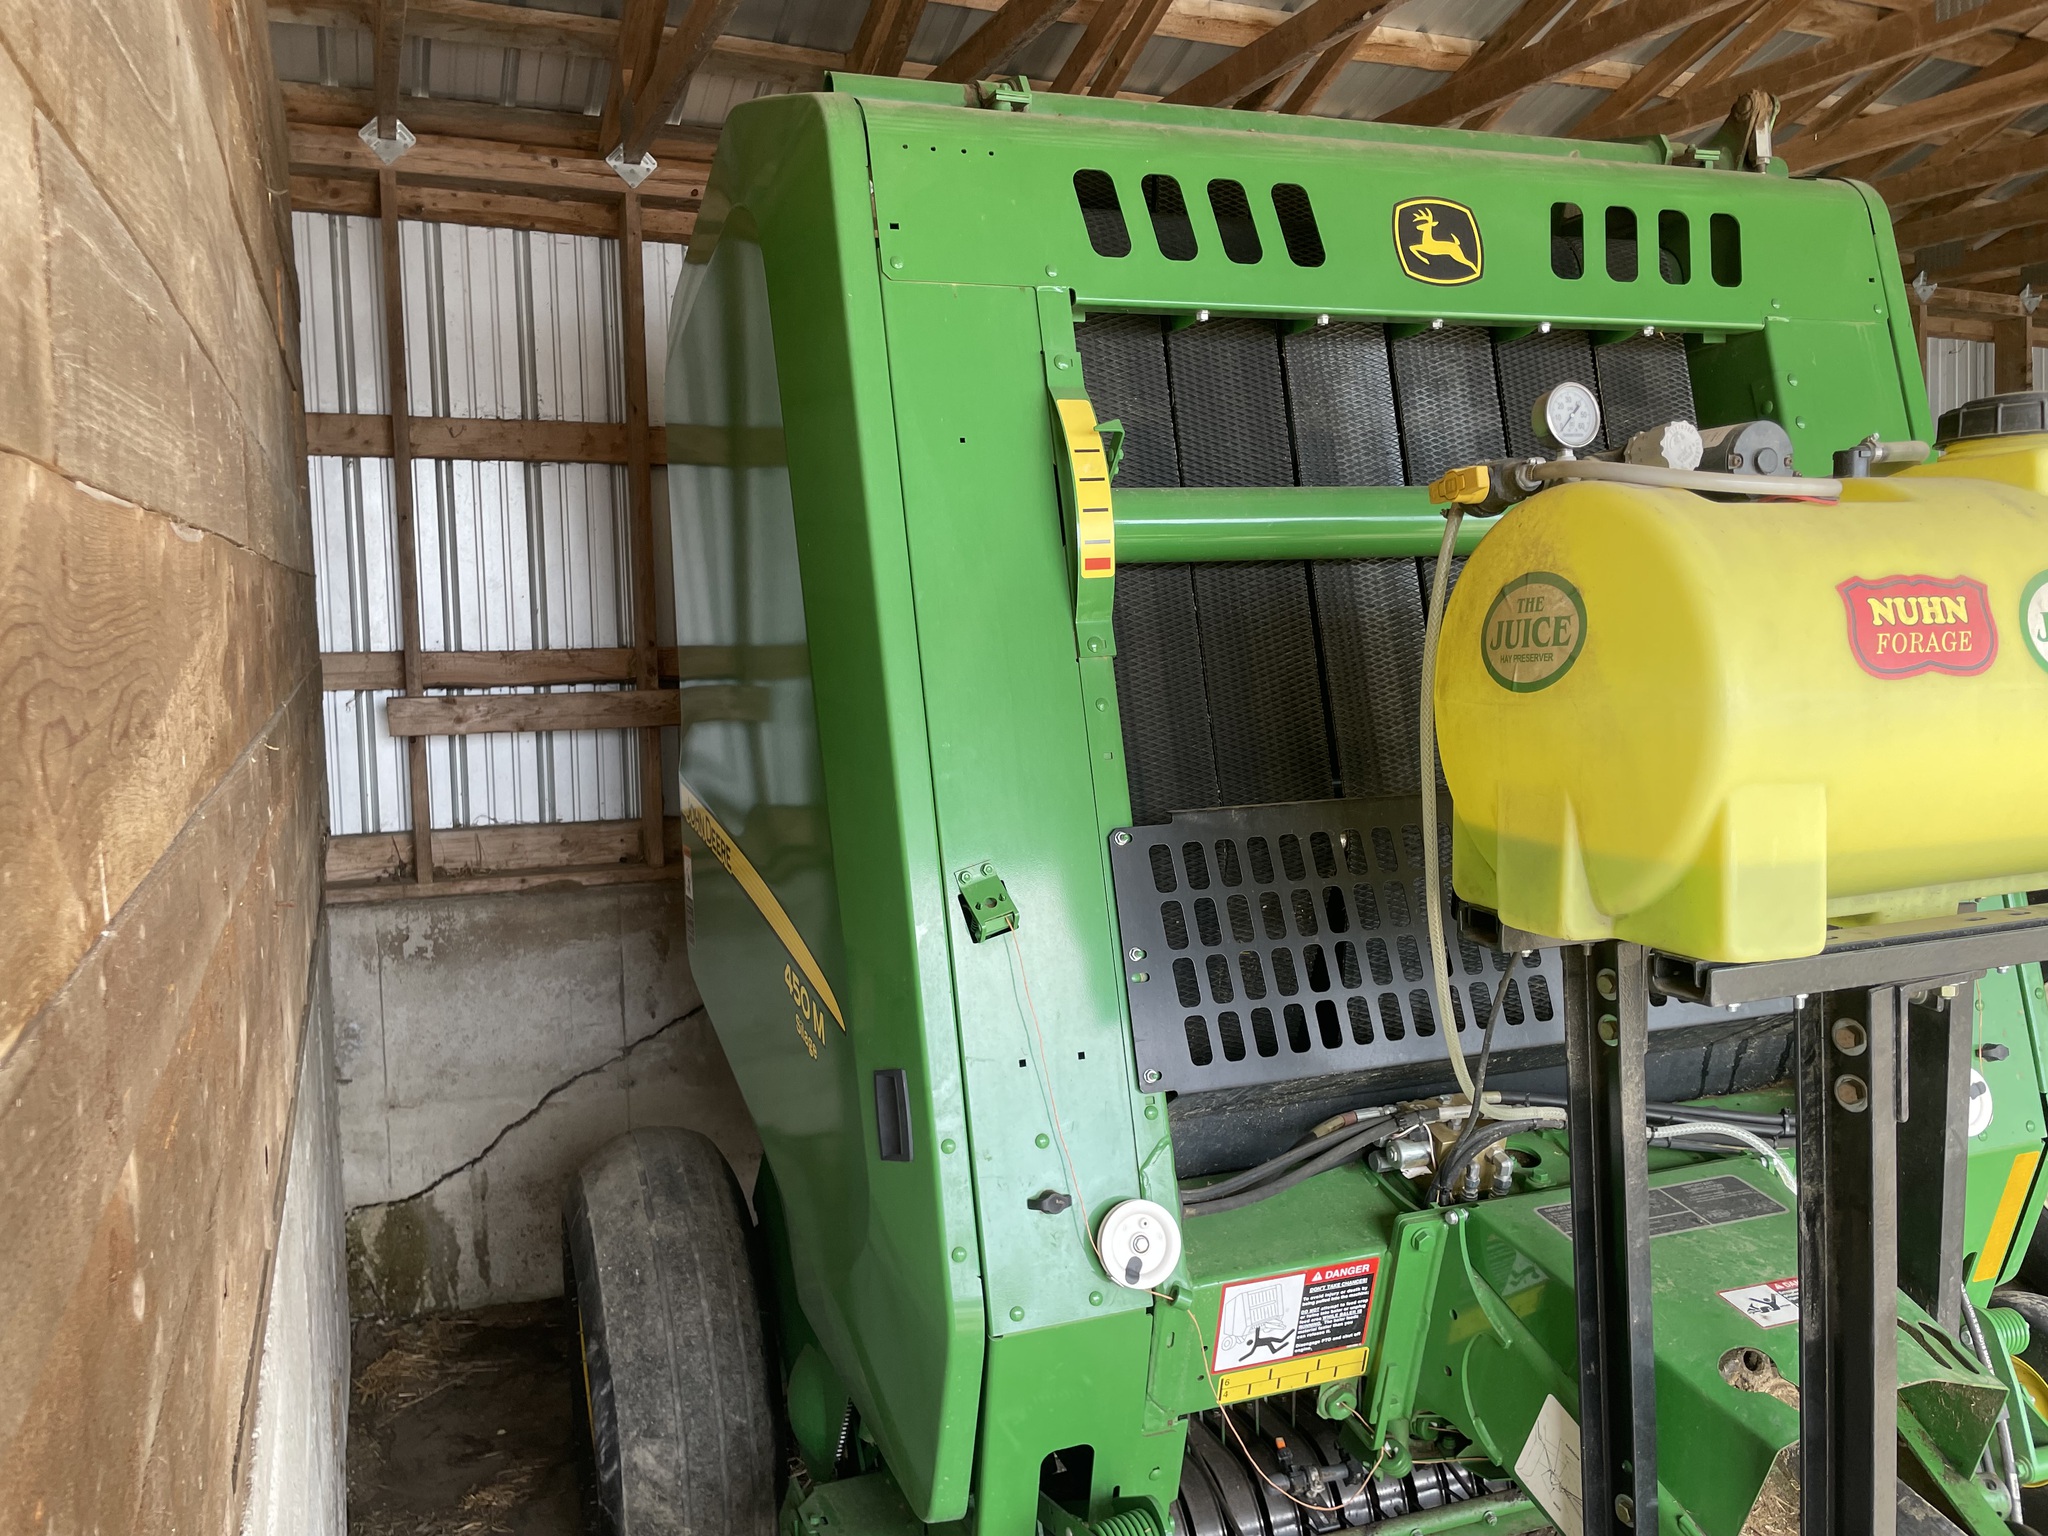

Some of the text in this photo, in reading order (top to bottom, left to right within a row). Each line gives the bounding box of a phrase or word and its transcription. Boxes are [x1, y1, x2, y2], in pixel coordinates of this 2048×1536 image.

[1517, 596, 1545, 613] THE
[1866, 596, 1969, 626] NUHN
[1490, 614, 1575, 651] JUICE
[1876, 630, 1973, 655] FORAGE
[1500, 652, 1554, 664] HAY PRESERVER
[705, 815, 732, 875] DEERE
[1325, 1264, 1370, 1280] DANGER
[1309, 1278, 1368, 1293] DON'T TAKE CHANCES!
[1295, 1340, 1321, 1348] Disengage
[1225, 1378, 1230, 1386] 6
